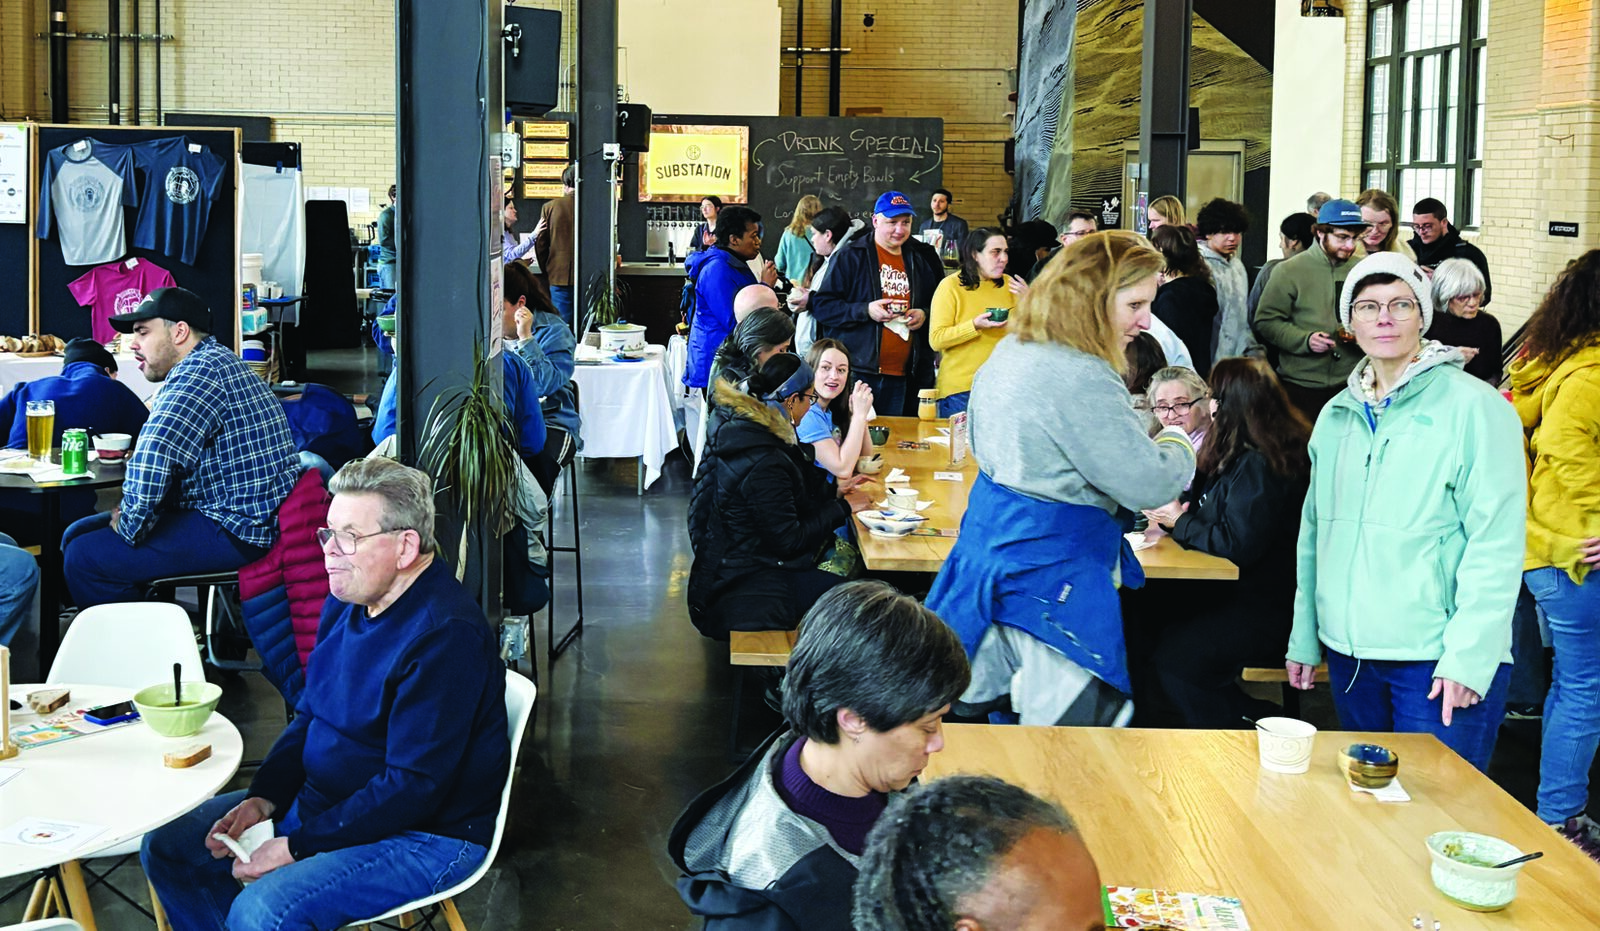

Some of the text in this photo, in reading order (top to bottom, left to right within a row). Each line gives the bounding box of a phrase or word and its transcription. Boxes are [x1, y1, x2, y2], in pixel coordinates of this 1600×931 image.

[778, 129, 937, 155] DRINK SPECIAL
[656, 163, 731, 180] SUBSTATION
[776, 161, 895, 193] Support Empty Bowls
